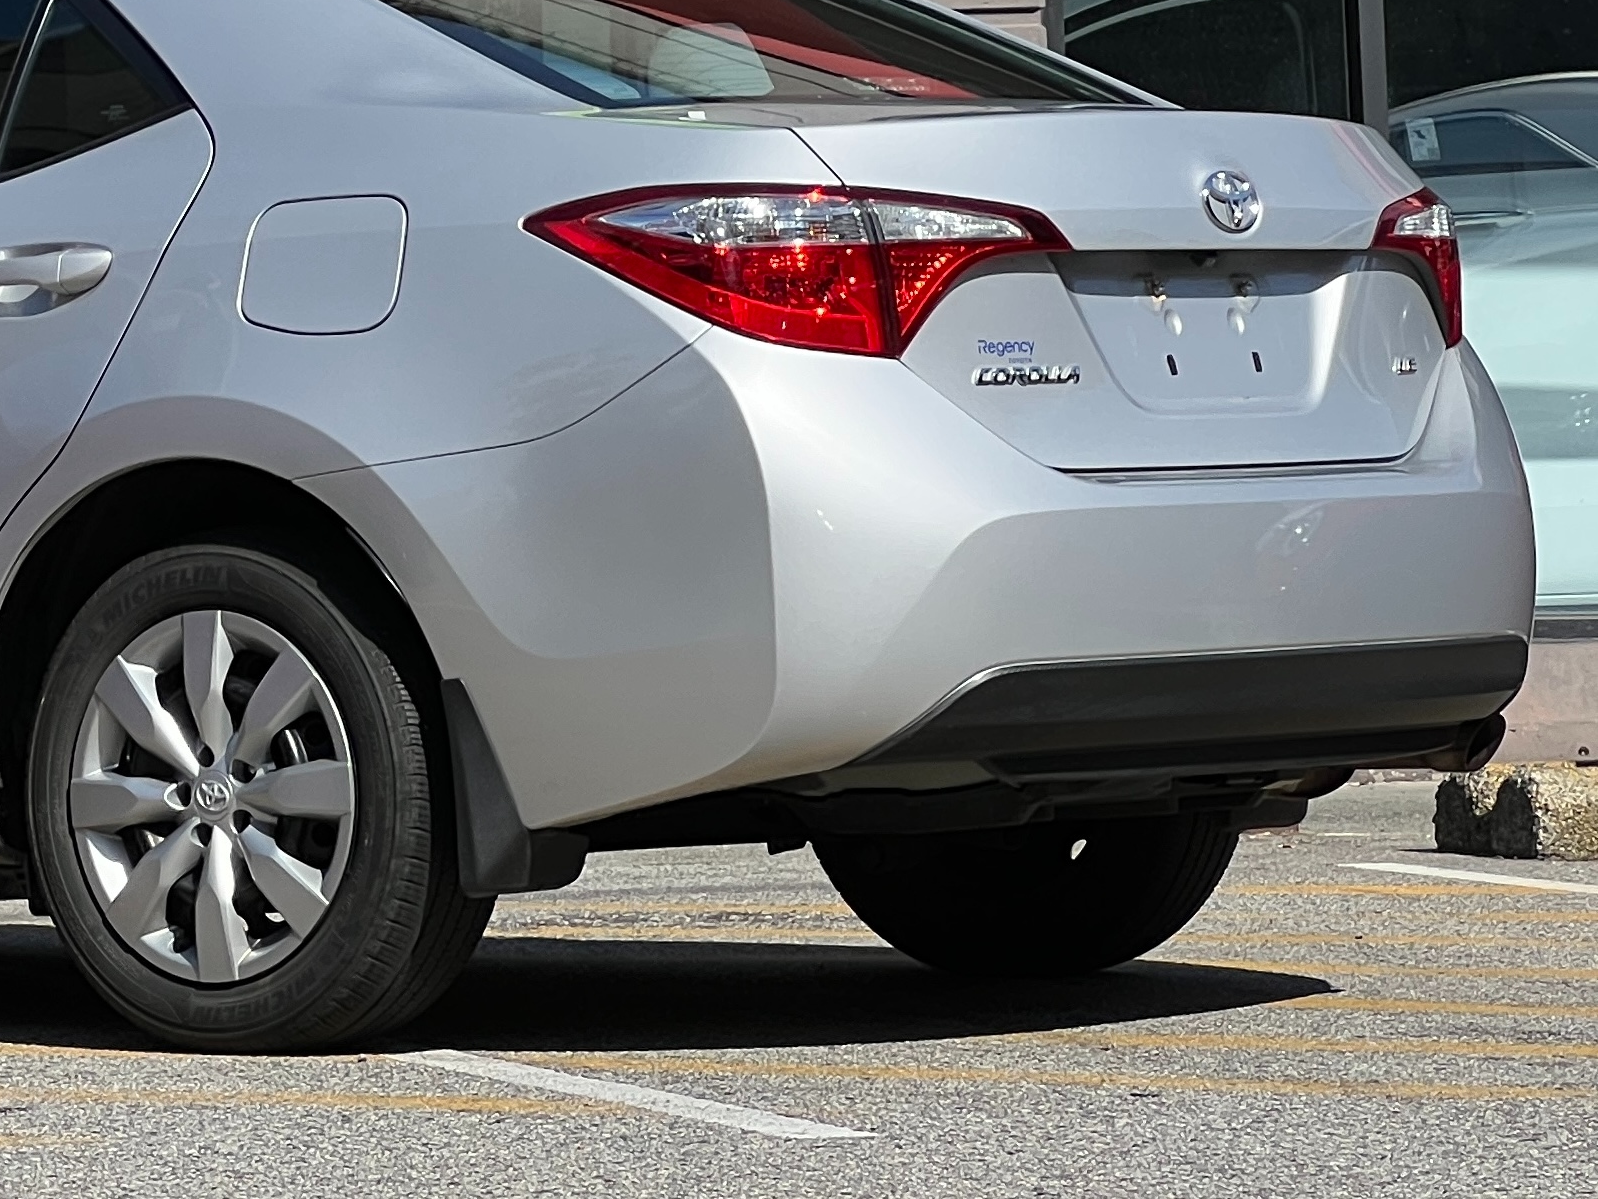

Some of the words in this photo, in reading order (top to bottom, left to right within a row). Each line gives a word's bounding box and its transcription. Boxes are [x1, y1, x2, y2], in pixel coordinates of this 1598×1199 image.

[977, 339, 1035, 357] Regency
[970, 364, 1081, 387] COROLLA
[102, 564, 224, 627] MICHELIN
